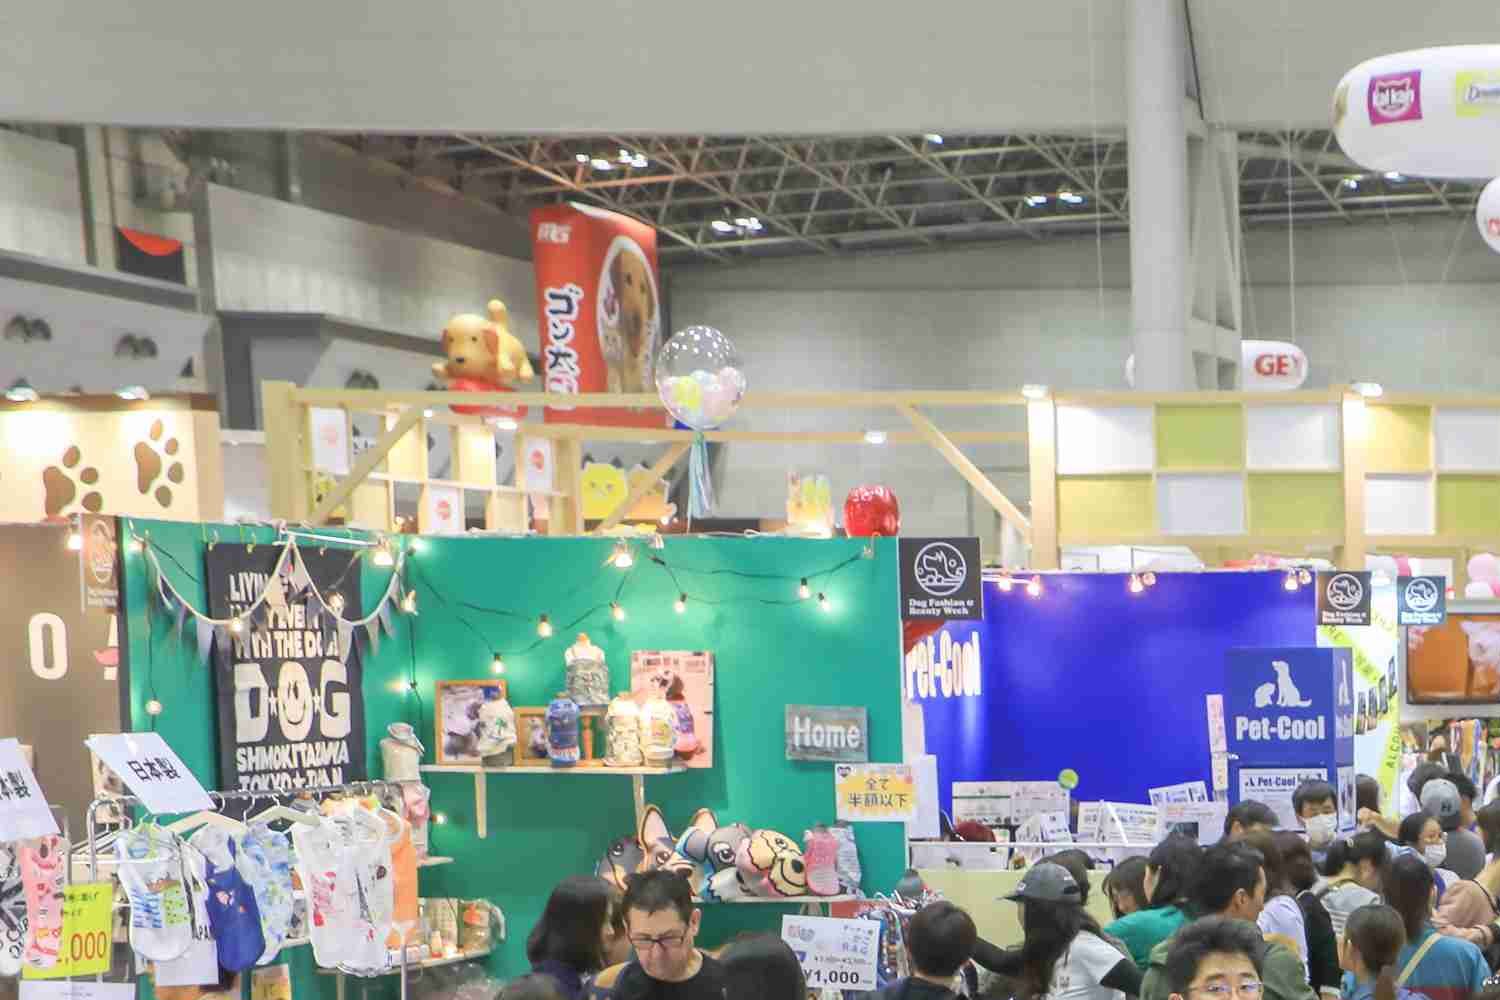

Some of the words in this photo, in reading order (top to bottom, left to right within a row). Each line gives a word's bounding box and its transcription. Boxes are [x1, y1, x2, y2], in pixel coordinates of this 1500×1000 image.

[909, 598, 927, 609] Dog
[929, 598, 965, 608] Fashion
[909, 607, 942, 617] Beauty
[794, 716, 860, 748] Home
[1235, 715, 1326, 741] Pet-Cool
[127, 757, 181, 781] 日本製
[866, 777, 889, 791] 全て
[60, 931, 107, 963] ,000
[804, 969, 859, 985] ¥1,000
